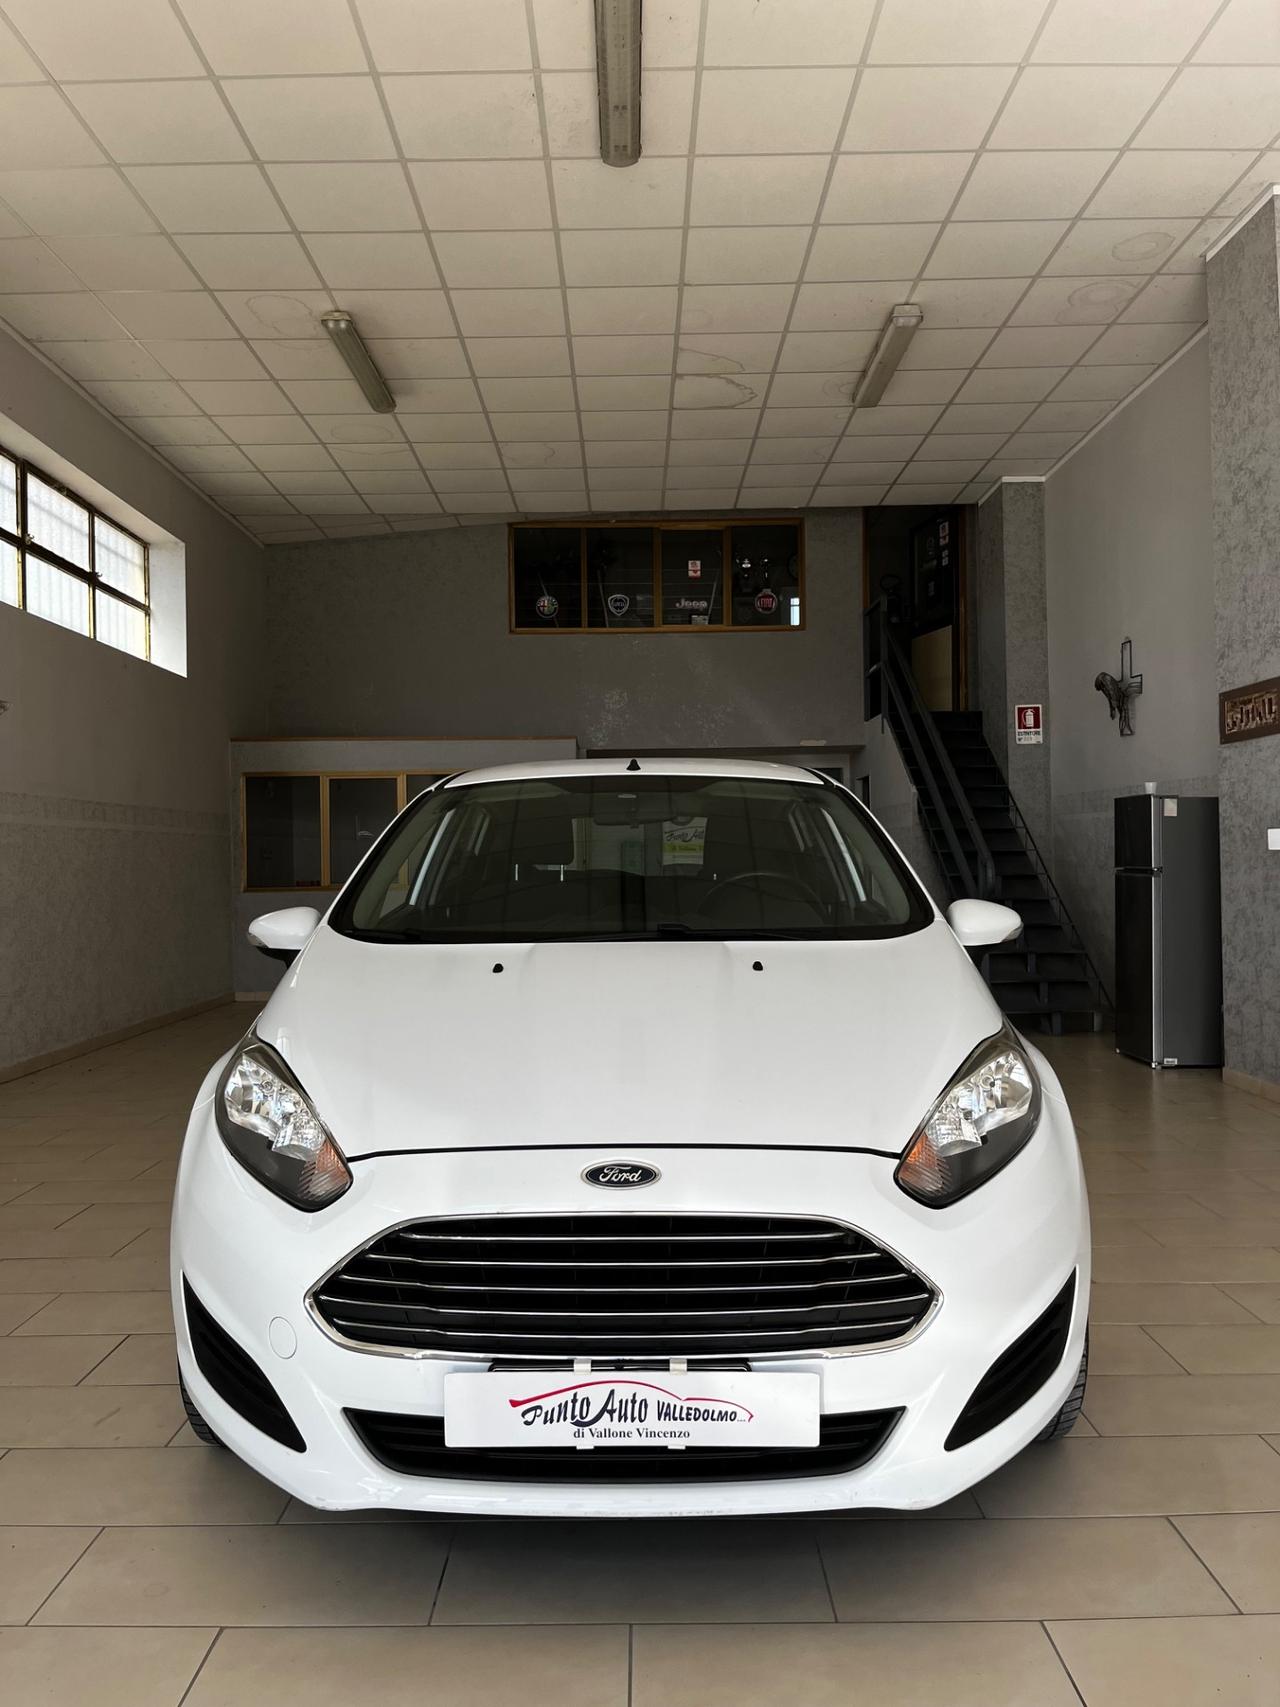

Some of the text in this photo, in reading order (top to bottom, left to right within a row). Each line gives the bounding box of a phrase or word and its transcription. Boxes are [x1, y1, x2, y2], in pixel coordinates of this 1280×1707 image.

[599, 1166, 642, 1182] Ford
[521, 1391, 591, 1426] Punto
[570, 1388, 649, 1427] Auto
[573, 1427, 691, 1439] di Vallone Vincenzo
